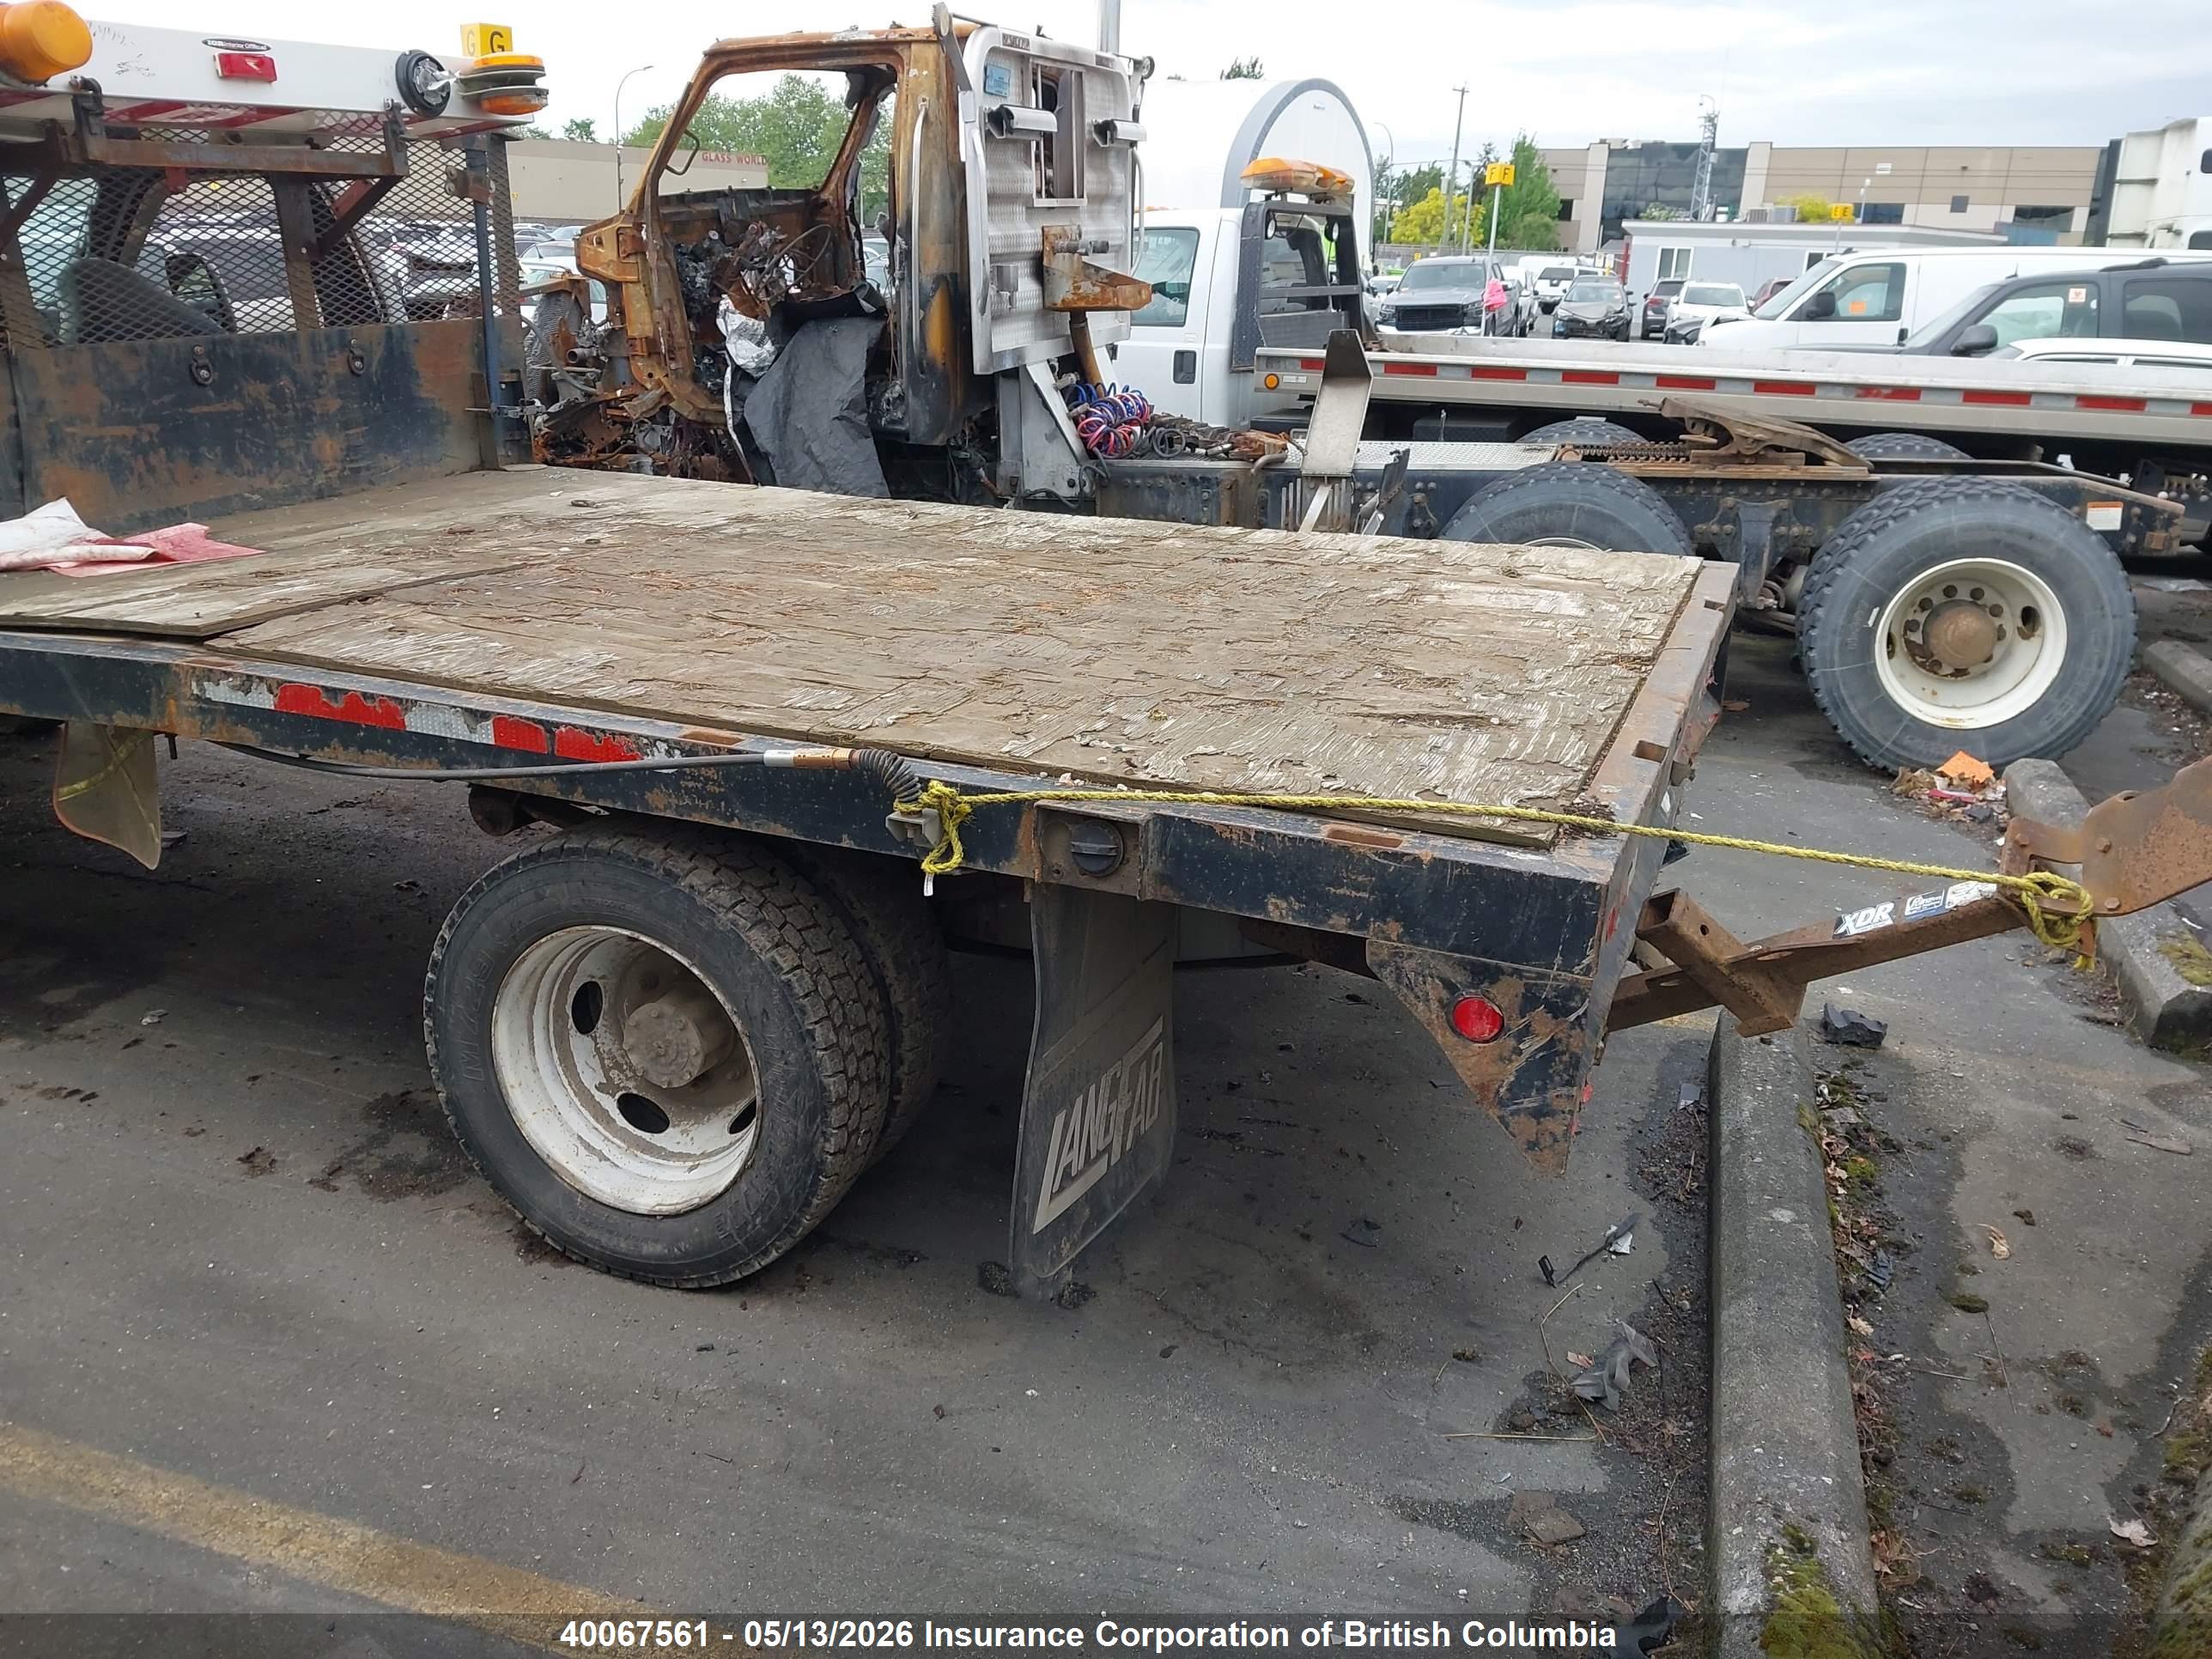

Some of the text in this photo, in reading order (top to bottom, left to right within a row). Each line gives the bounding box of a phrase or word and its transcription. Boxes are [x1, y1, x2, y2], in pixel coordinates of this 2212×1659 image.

[467, 29, 476, 56] G
[489, 30, 506, 53] G
[702, 152, 767, 165] GLASS WORLD
[1490, 167, 1497, 180] F
[1503, 167, 1510, 180] F
[1842, 206, 1849, 216] E
[1833, 901, 1895, 935] XDR
[1032, 1015, 1164, 1235] LANGFAB
